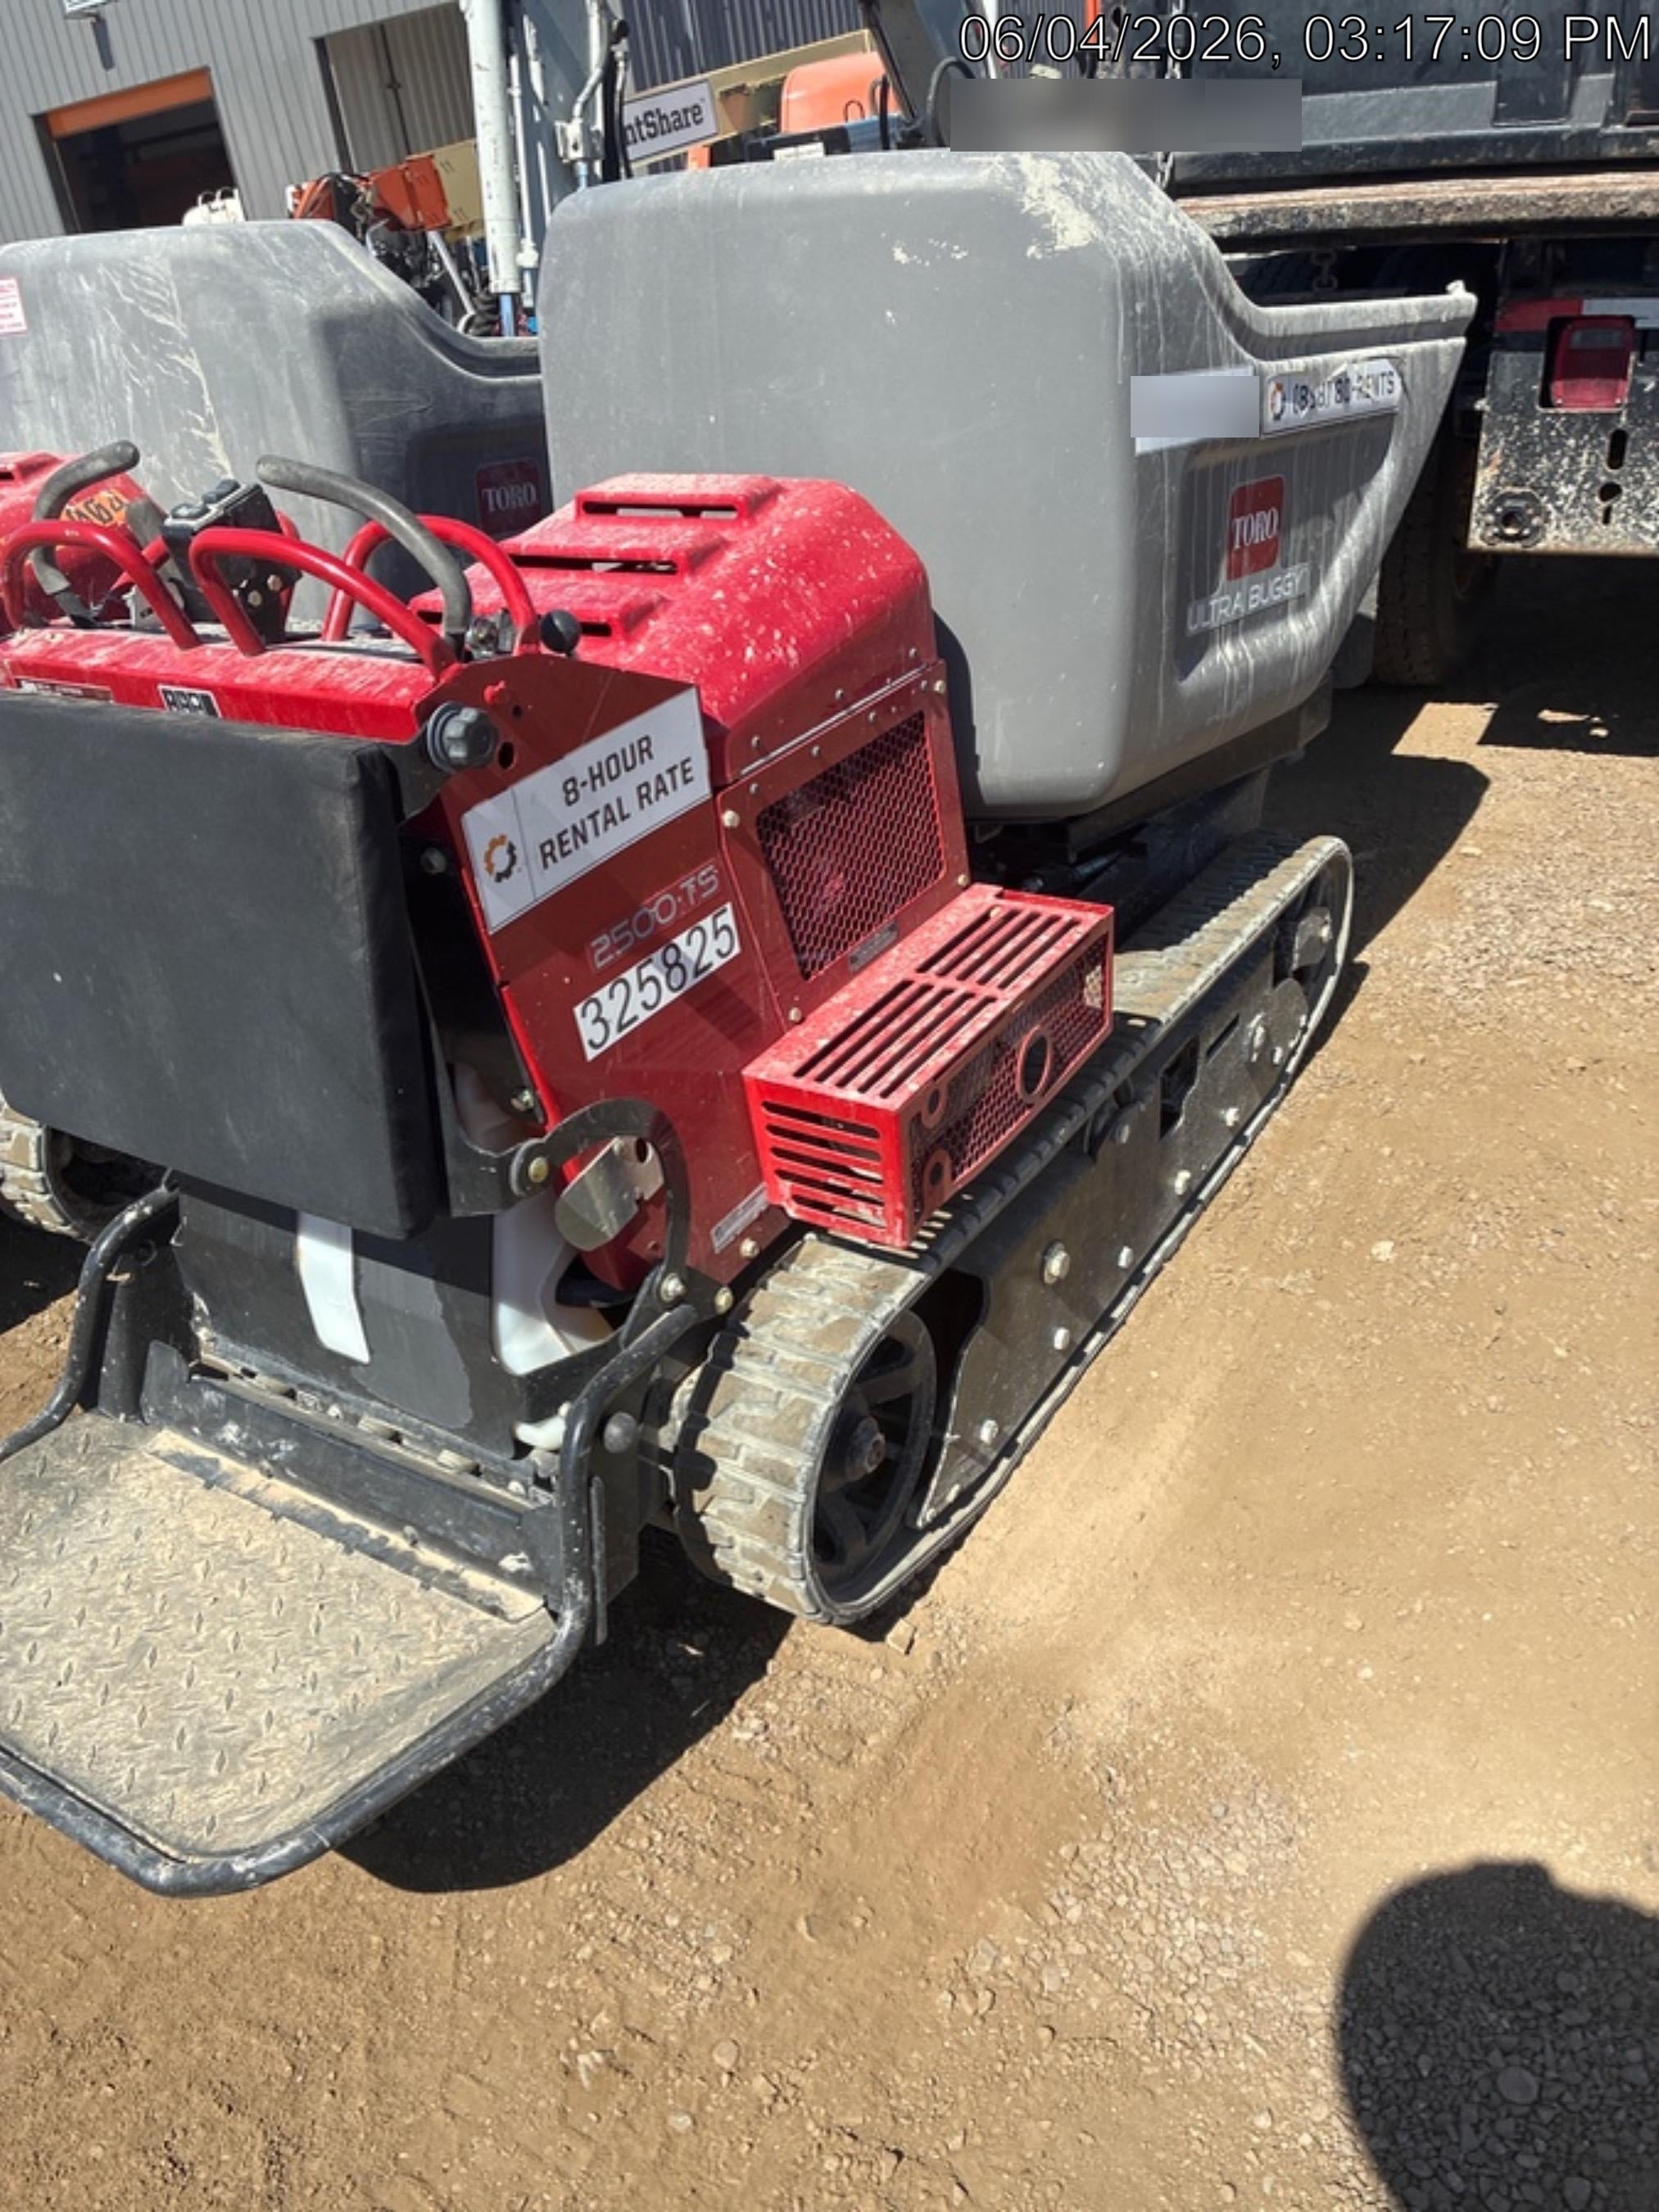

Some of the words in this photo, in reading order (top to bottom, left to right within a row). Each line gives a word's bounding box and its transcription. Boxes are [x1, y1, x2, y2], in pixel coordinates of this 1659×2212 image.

[624, 102, 704, 146] ntShare
[481, 481, 538, 512] TORO
[1233, 507, 1279, 551] TORO
[1249, 569, 1306, 610] BUGGY
[562, 734, 654, 807] 8-HOUR
[538, 796, 631, 871] RENTAL
[636, 756, 695, 812] RATE
[581, 906, 735, 1050] 325825
